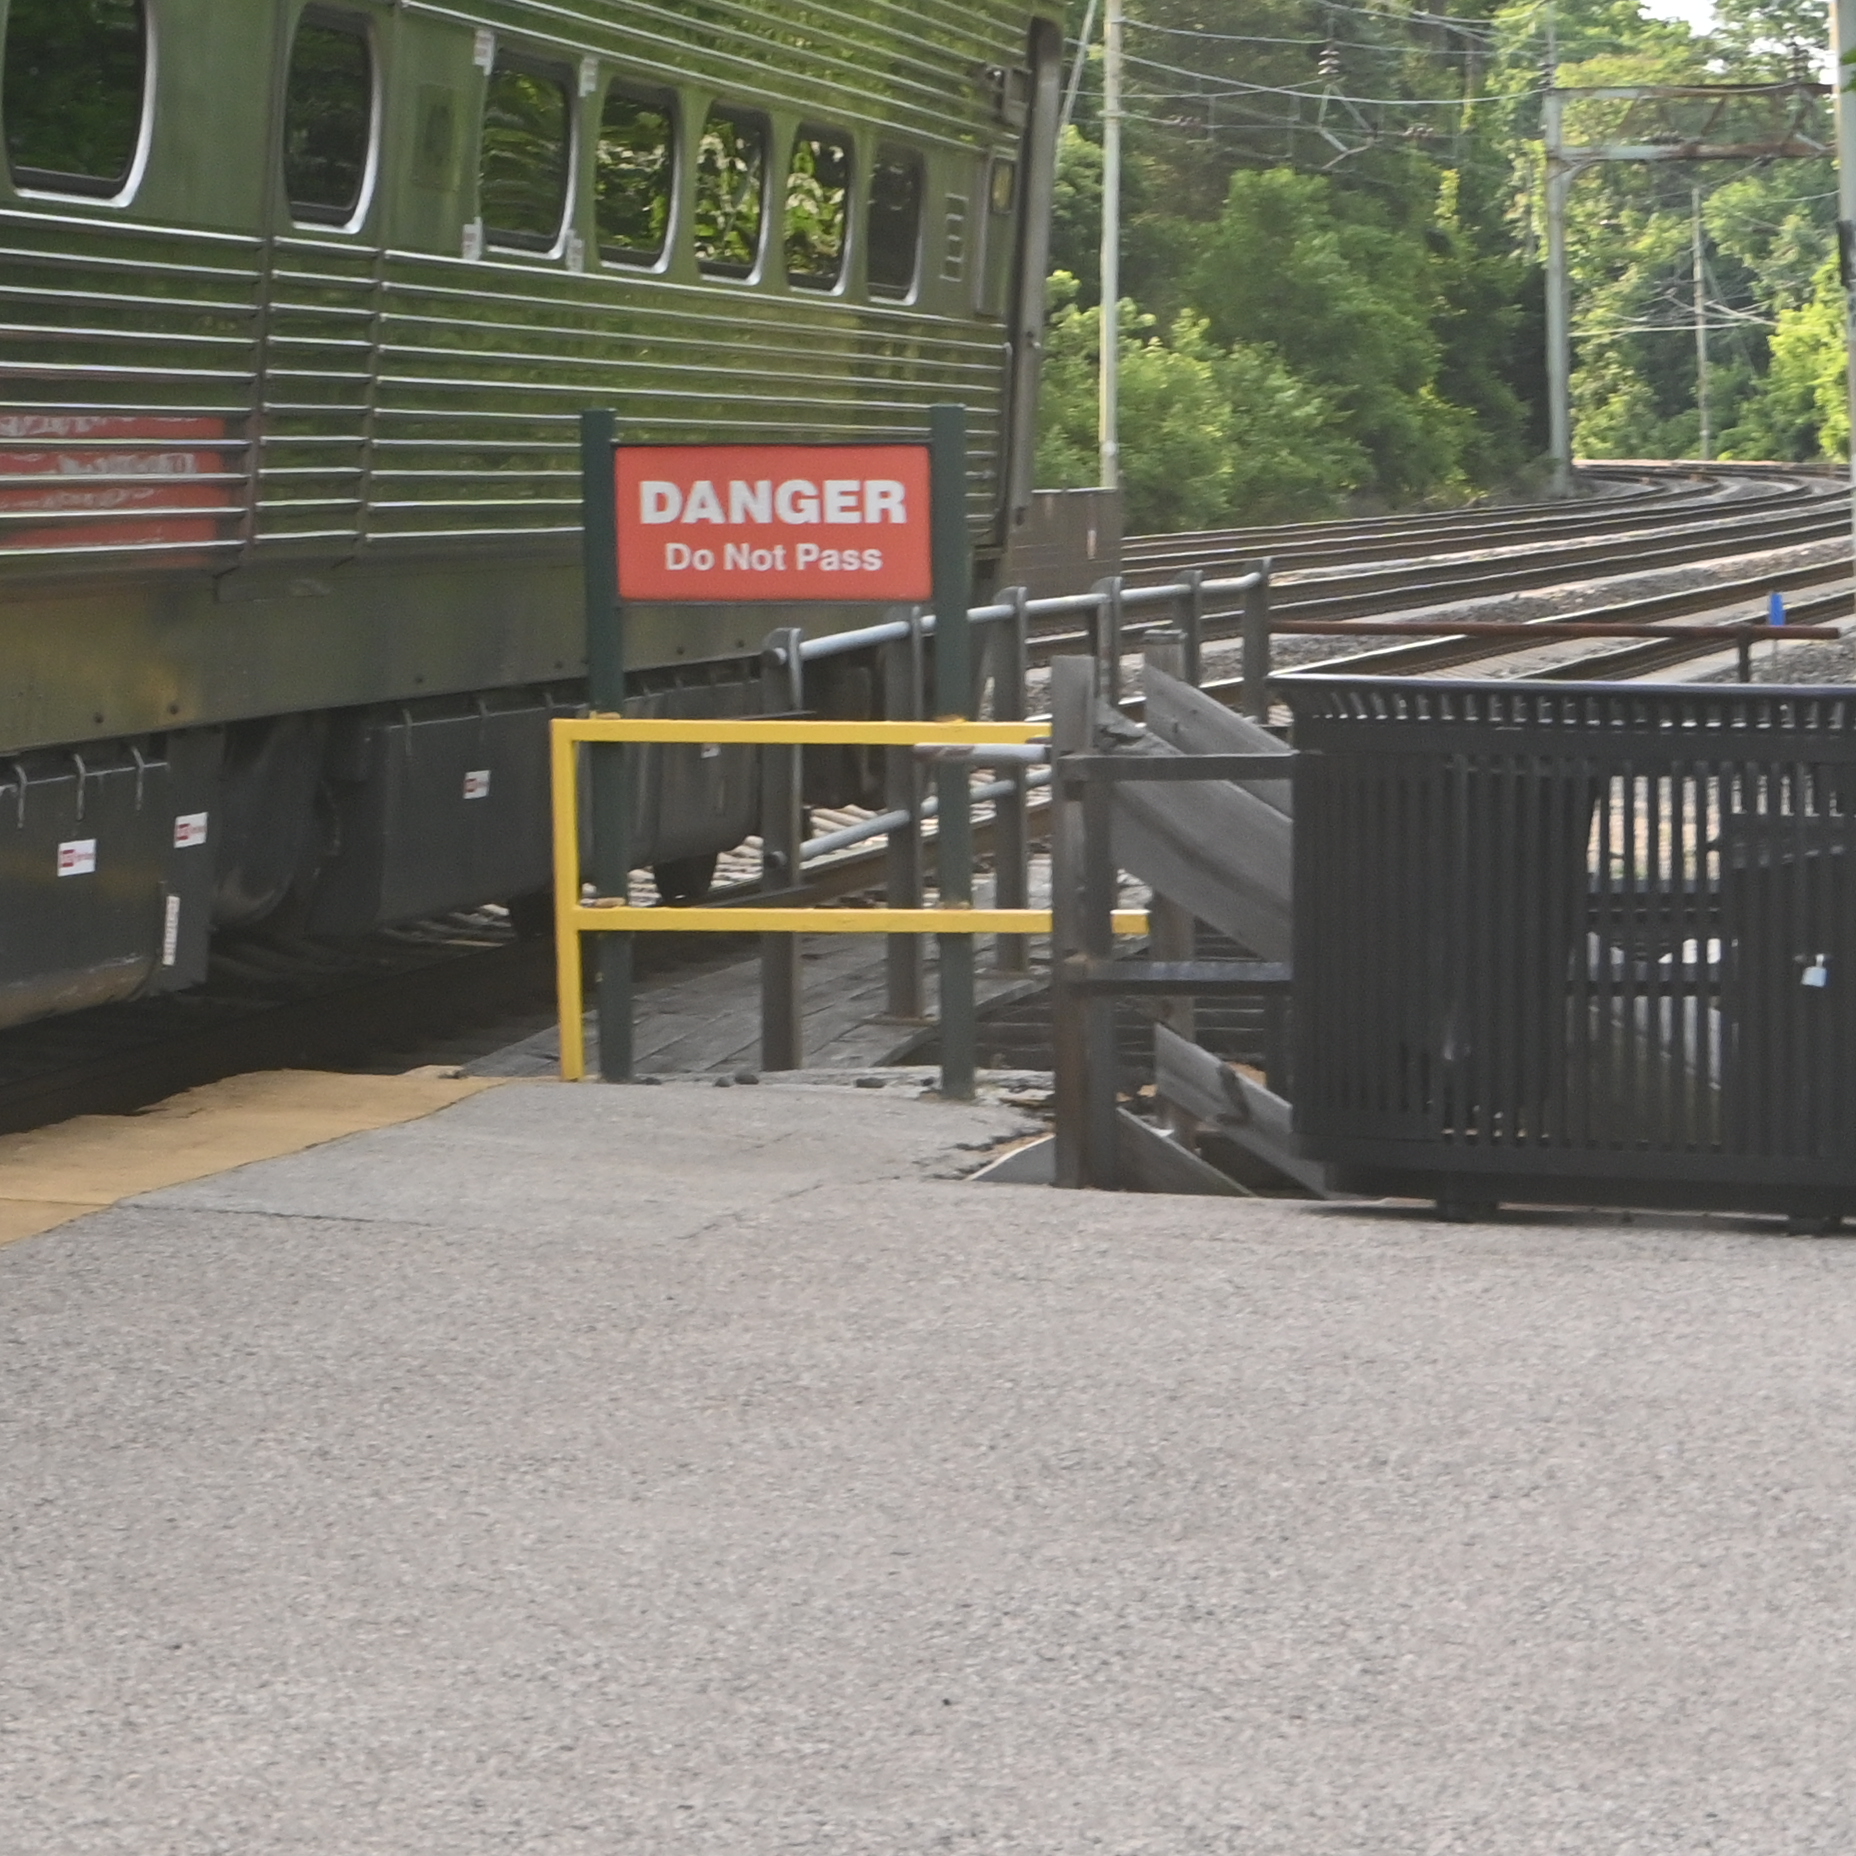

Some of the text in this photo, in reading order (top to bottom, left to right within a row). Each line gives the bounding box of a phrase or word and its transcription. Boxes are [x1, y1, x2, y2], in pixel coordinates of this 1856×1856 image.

[639, 479, 907, 525] DANGER
[665, 542, 883, 572] Do Not Pass
